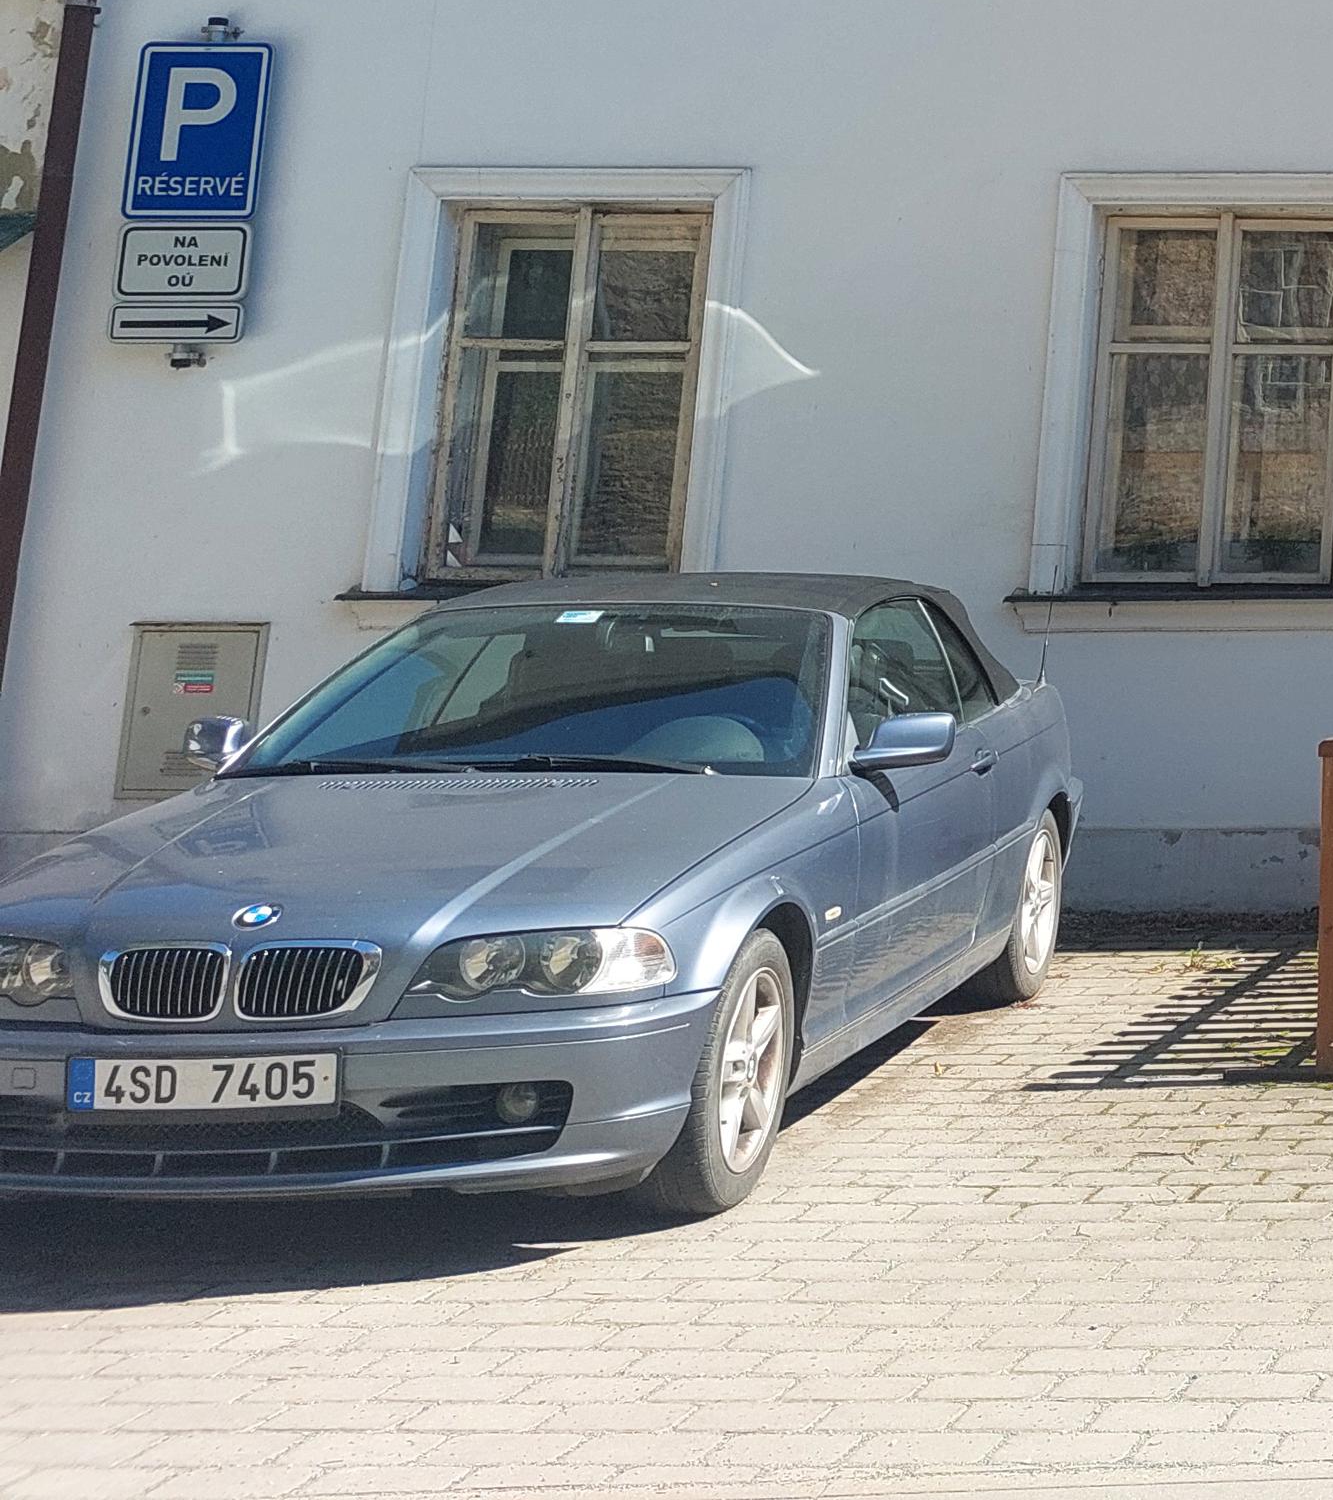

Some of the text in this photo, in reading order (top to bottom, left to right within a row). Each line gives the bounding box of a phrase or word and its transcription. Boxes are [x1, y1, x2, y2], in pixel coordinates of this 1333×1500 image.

[159, 67, 238, 162] P
[136, 171, 245, 197] RÉSERVÉ
[173, 235, 199, 249] NA
[137, 252, 230, 267] POVOLENÍ
[103, 1059, 317, 1105] 4SD 7405
[72, 1091, 91, 1103] CZ
